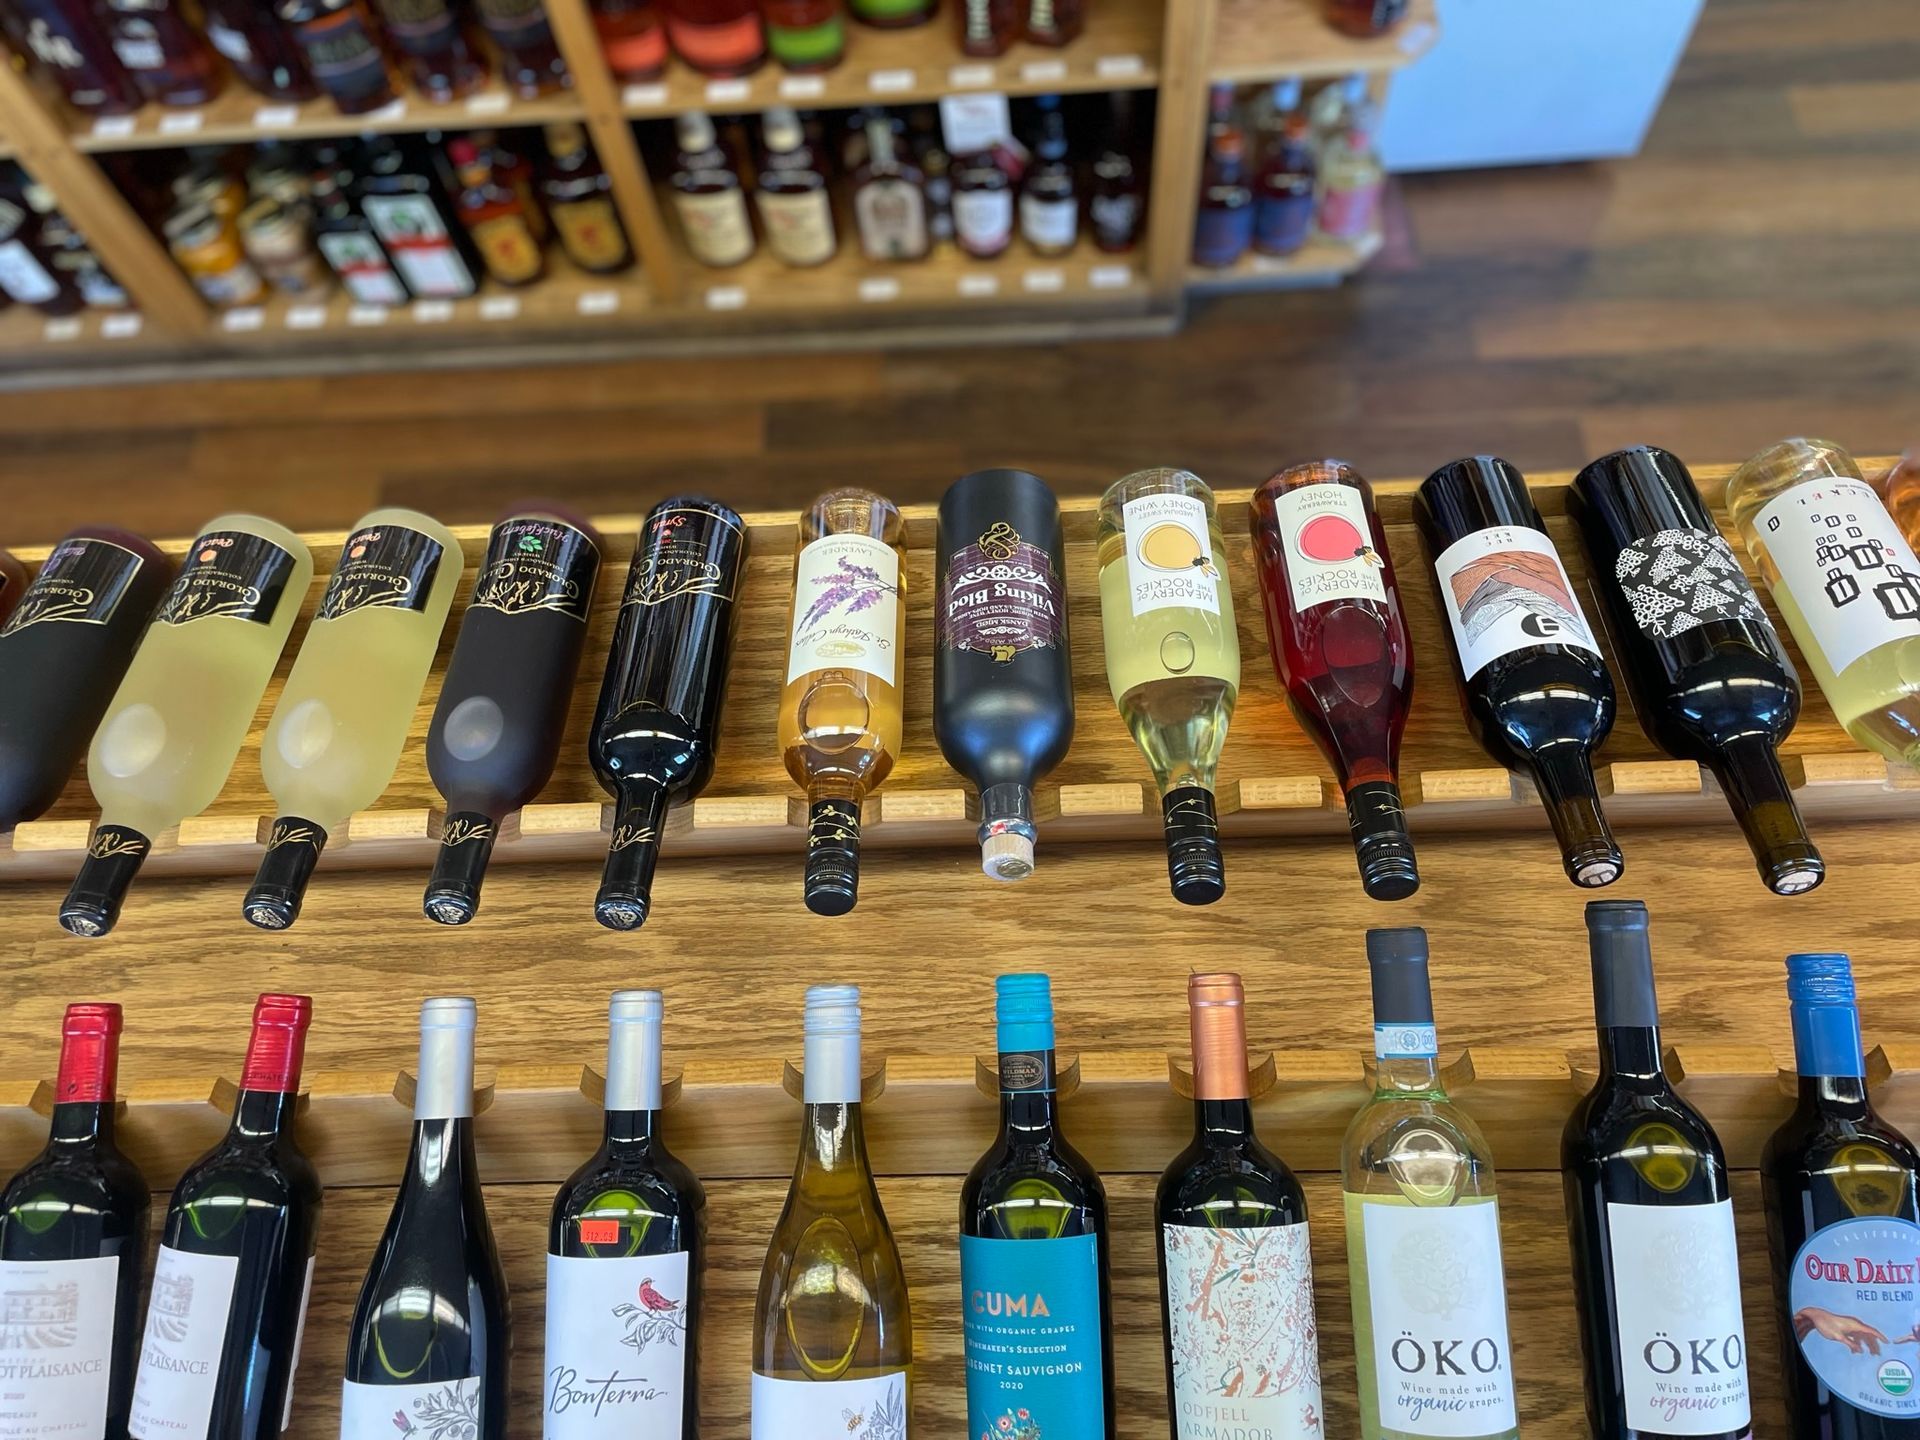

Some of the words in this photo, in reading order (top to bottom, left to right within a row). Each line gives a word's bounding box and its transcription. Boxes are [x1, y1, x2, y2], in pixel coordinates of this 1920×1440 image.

[1299, 490, 1343, 503] HONEY
[1127, 501, 1158, 516] WINE
[1161, 499, 1200, 514] HONEY
[499, 523, 570, 543] Huckleberry
[652, 515, 687, 534] Syrah
[657, 558, 721, 580] COLORADO
[1362, 573, 1377, 582] THE
[345, 572, 412, 594] COLORADO
[519, 565, 580, 600] COLORADO
[1136, 577, 1193, 595] ROCKIES
[1196, 583, 1211, 592] THE
[1298, 569, 1357, 589] ROCKIES
[1315, 579, 1380, 594] MEADERY
[192, 579, 261, 606] COLORADO
[993, 582, 1056, 617] Viking
[1151, 587, 1213, 602] MEADERY
[948, 588, 989, 618] Blod
[971, 1289, 1051, 1318] CUMA
[1856, 1289, 1878, 1302] RED
[1882, 1290, 1914, 1302] BLEND
[996, 1327, 1037, 1336] ORGANIC
[1040, 1324, 1076, 1336] GRAPES
[1016, 1344, 1067, 1354] SELECTION
[19, 1358, 104, 1379] PLAISANCE
[1007, 1361, 1083, 1377] SAUVIGNON
[549, 1365, 668, 1418] Bonterra
[999, 1381, 1024, 1390] 2020
[1400, 1381, 1432, 1394] Wine
[1439, 1385, 1470, 1395] made
[1475, 1381, 1498, 1393] with
[1655, 1382, 1689, 1394] Wine
[1695, 1382, 1722, 1394] made
[1726, 1376, 1742, 1390] with
[1182, 1401, 1251, 1422] ODFJELL
[1397, 1394, 1468, 1421] organic
[1650, 1394, 1720, 1422] organic
